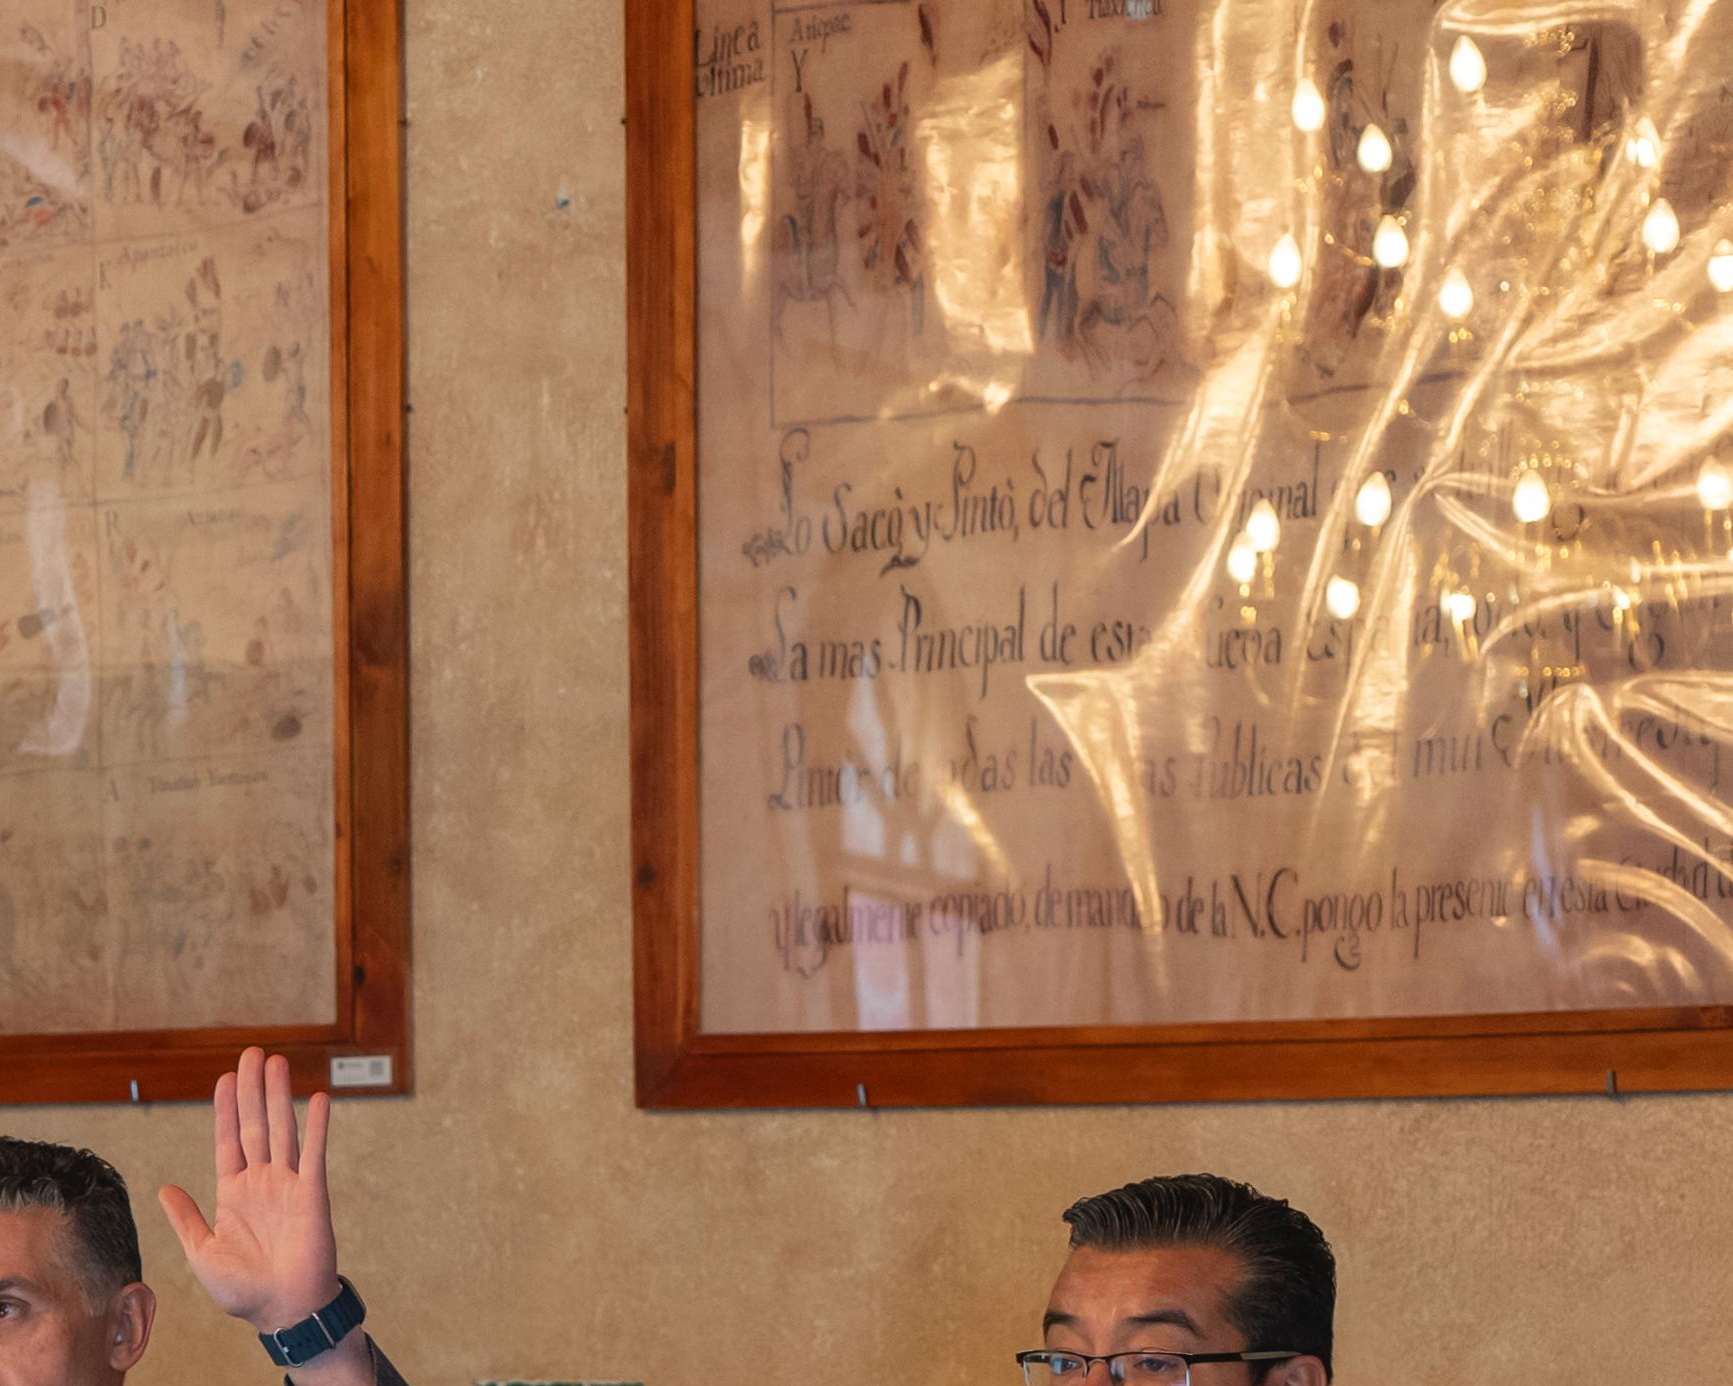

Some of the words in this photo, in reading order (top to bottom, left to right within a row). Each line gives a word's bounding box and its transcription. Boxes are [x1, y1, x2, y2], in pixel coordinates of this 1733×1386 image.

[91, 6, 106, 29] D
[791, 49, 809, 93] Y
[820, 638, 881, 681] mas
[889, 584, 1025, 700] Principal
[1040, 581, 1077, 665] de
[1177, 876, 1205, 935] de
[1391, 868, 1409, 929] la
